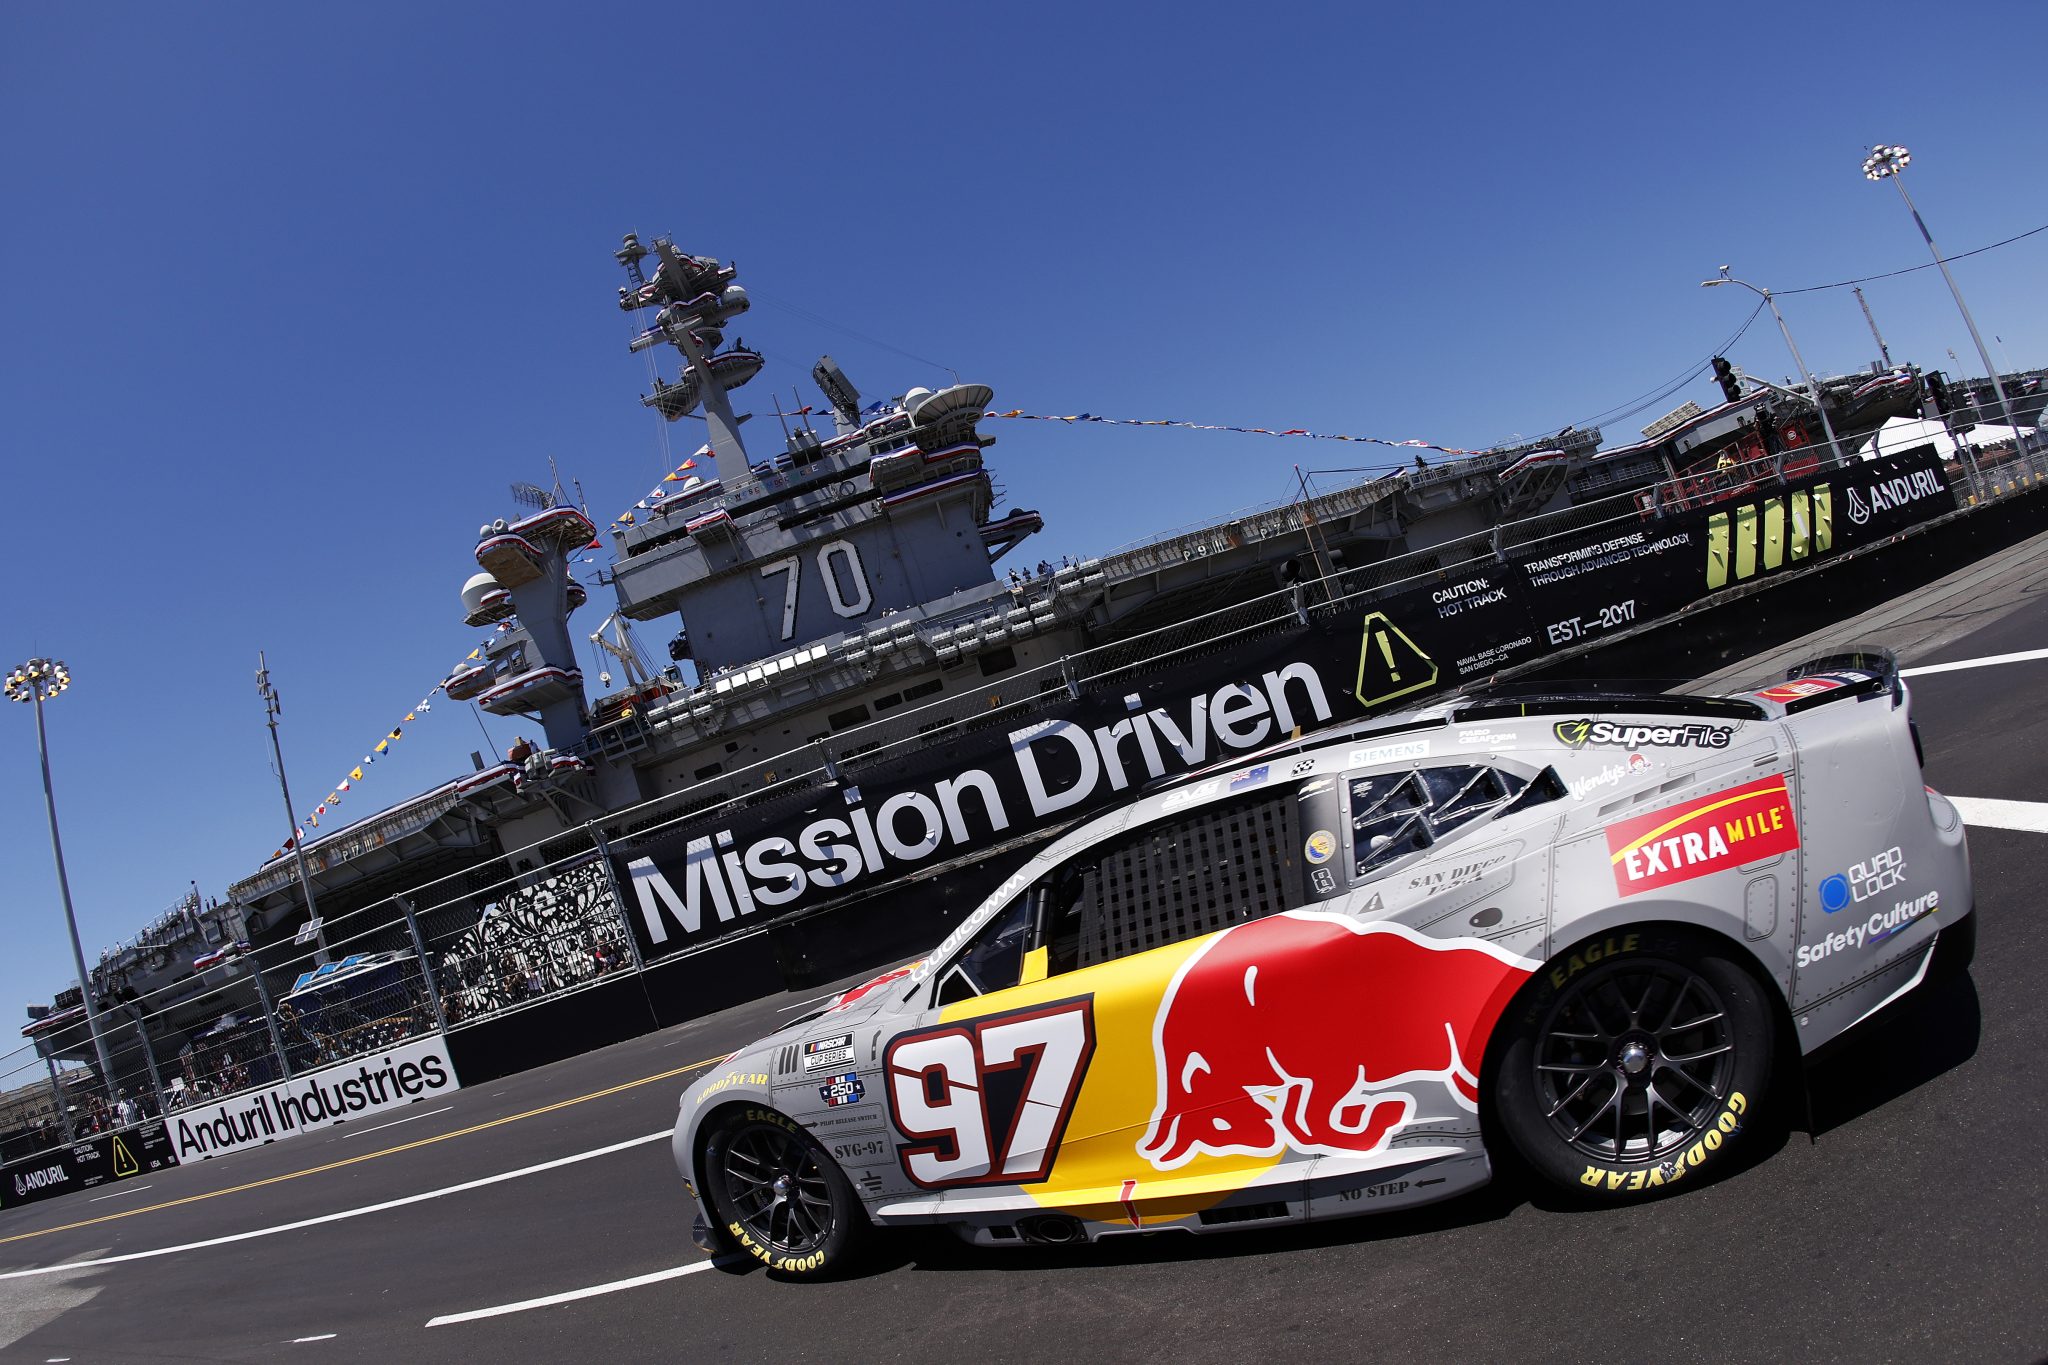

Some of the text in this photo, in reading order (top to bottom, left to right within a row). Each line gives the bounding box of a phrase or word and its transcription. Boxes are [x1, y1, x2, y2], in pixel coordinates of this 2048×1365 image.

[1870, 468, 1945, 514] ANDURIL
[1524, 532, 1646, 574] TRANSFORMING DEFENSE
[1530, 533, 1691, 587] THROUGH ADVANCED TECHNOLOGY
[761, 540, 872, 640] 70
[1432, 578, 1490, 603] CAUTION:
[1438, 587, 1507, 618] HOT TRACK
[1456, 637, 1532, 667] NAVAL BASE CORONADO
[1459, 666, 1474, 675] SAN
[1354, 743, 1425, 763] SIEMENS
[1569, 764, 1626, 800] Wendy's
[626, 662, 1332, 944] Mission Driven
[1408, 855, 1507, 889] SAN DIEGO
[1848, 846, 1902, 884] QUAD
[1852, 864, 1906, 903] LOCK
[1797, 890, 1939, 968] SafetyCulture
[1551, 933, 1641, 990] EAGLE
[811, 1049, 847, 1066] CUP SERIES
[818, 1036, 847, 1050] NASCAR
[177, 1054, 448, 1157] Anduril Industries
[830, 1082, 854, 1097] 250
[887, 1003, 1092, 1184] 97
[746, 1109, 798, 1134] EAGLE
[835, 1117, 857, 1125] RELEASE
[857, 1114, 877, 1122] SWITCH
[834, 1141, 884, 1159] SVG-97
[1580, 1092, 1747, 1191] GOODYEAR
[26, 1164, 69, 1191] ANDURIL
[1339, 1181, 1410, 1201] NO STEP
[729, 1221, 825, 1272] GOODYEAR
